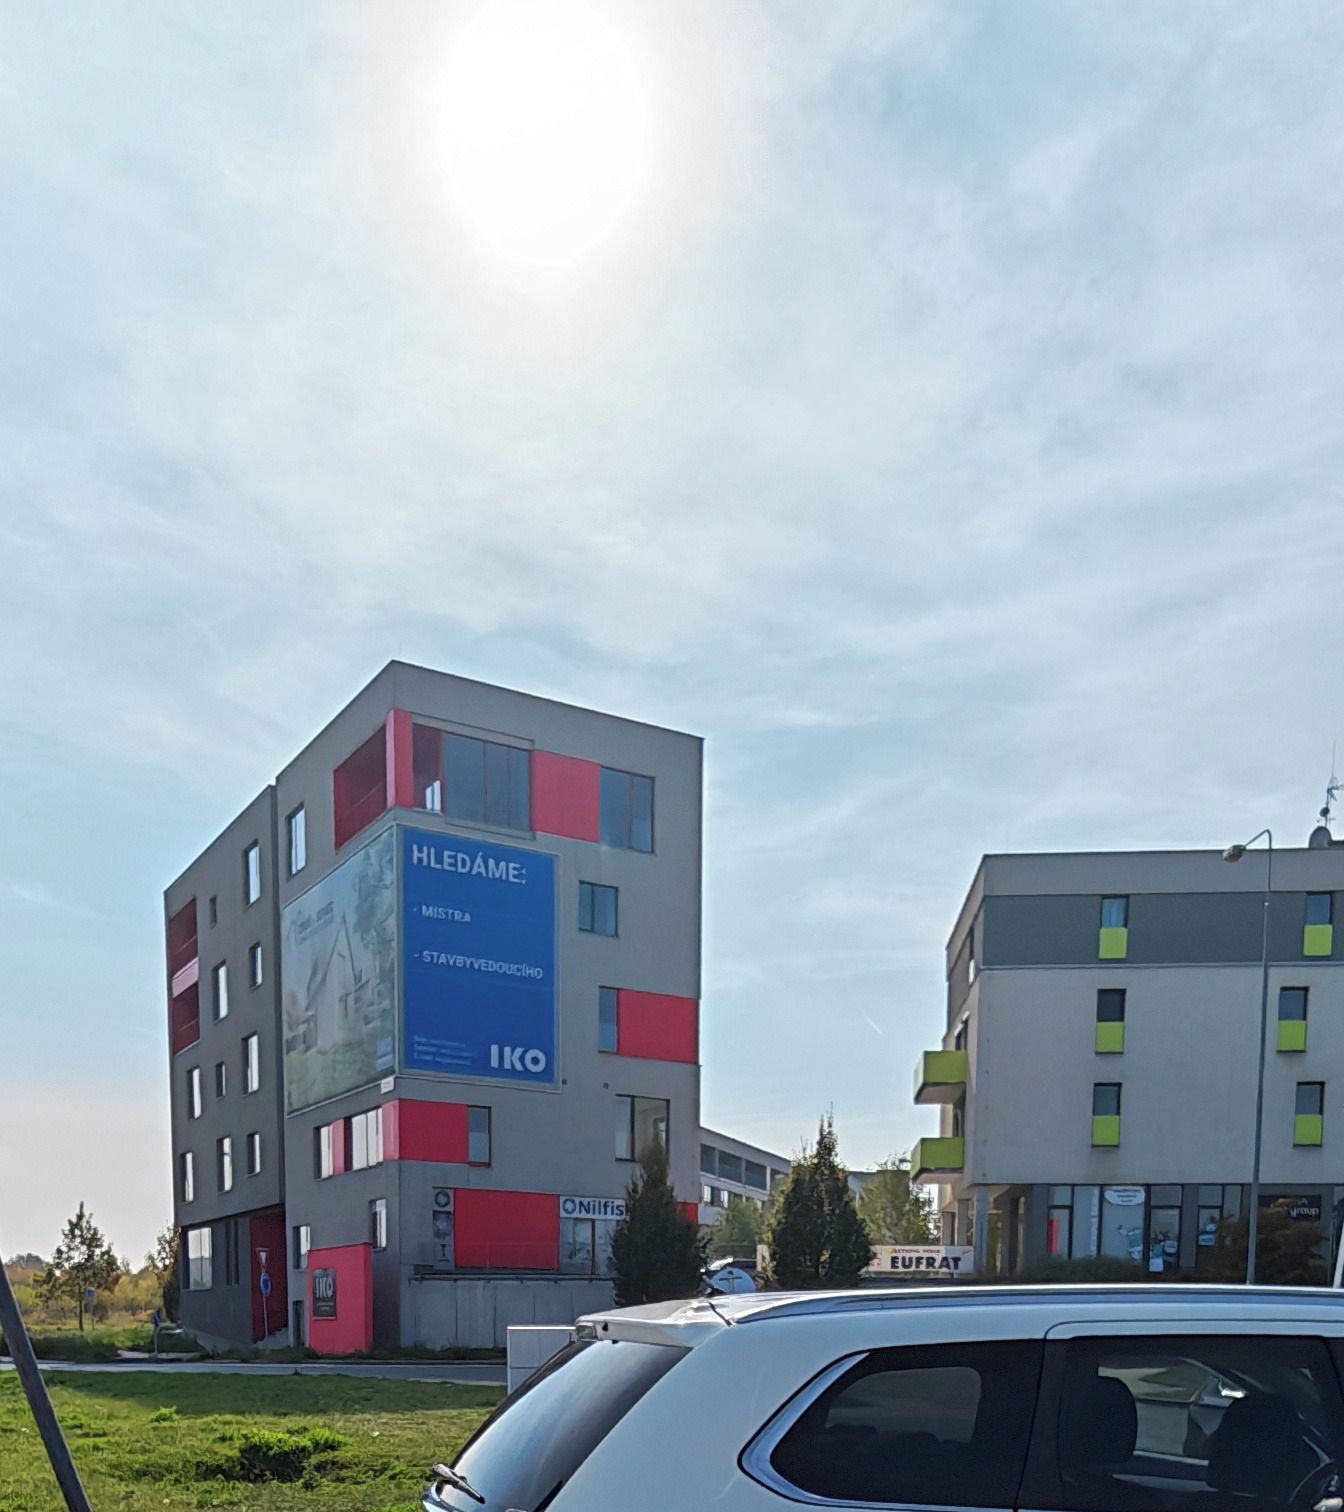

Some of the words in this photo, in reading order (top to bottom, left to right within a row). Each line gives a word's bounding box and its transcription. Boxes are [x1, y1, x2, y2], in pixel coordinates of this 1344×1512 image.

[421, 904, 472, 923] MISTRA
[422, 950, 544, 980] STAVBYVEDOUCÍHO
[490, 1044, 546, 1073] IKO
[890, 1256, 961, 1270] EUFRAT
